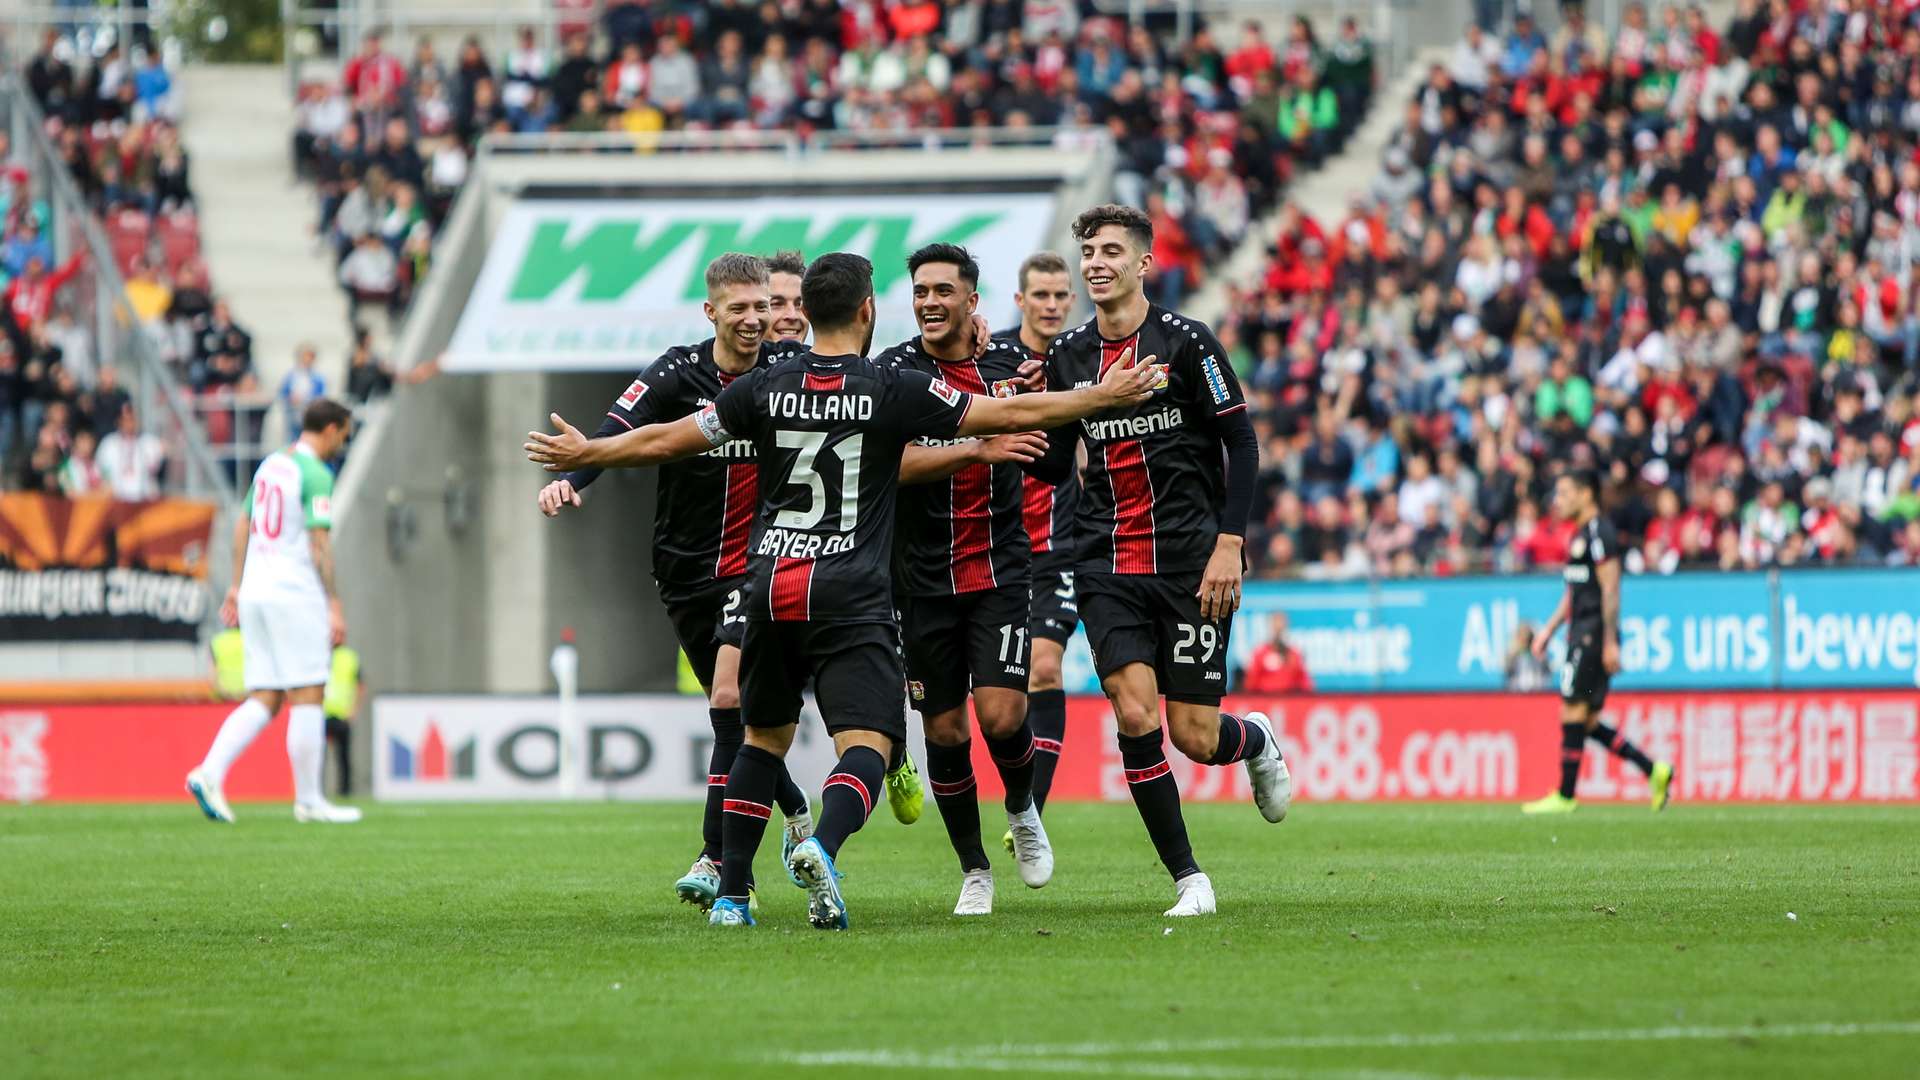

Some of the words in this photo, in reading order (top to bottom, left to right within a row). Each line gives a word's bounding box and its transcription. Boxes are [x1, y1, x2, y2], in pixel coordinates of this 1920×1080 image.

[1200, 358, 1222, 405] TRAINING
[1208, 354, 1231, 402] KIESER
[768, 391, 873, 421] VOLLAND
[1080, 406, 1184, 441] Barmenia
[772, 429, 865, 533] 31
[756, 528, 822, 559] BAYER
[722, 588, 747, 627] 2
[998, 623, 1025, 665] 11
[1173, 622, 1217, 665] 29
[1619, 614, 1673, 672] as
[1683, 614, 1770, 672] uns
[1784, 593, 1920, 674] bewe
[1004, 664, 1025, 677] JAKO
[1204, 670, 1222, 681] JAKO
